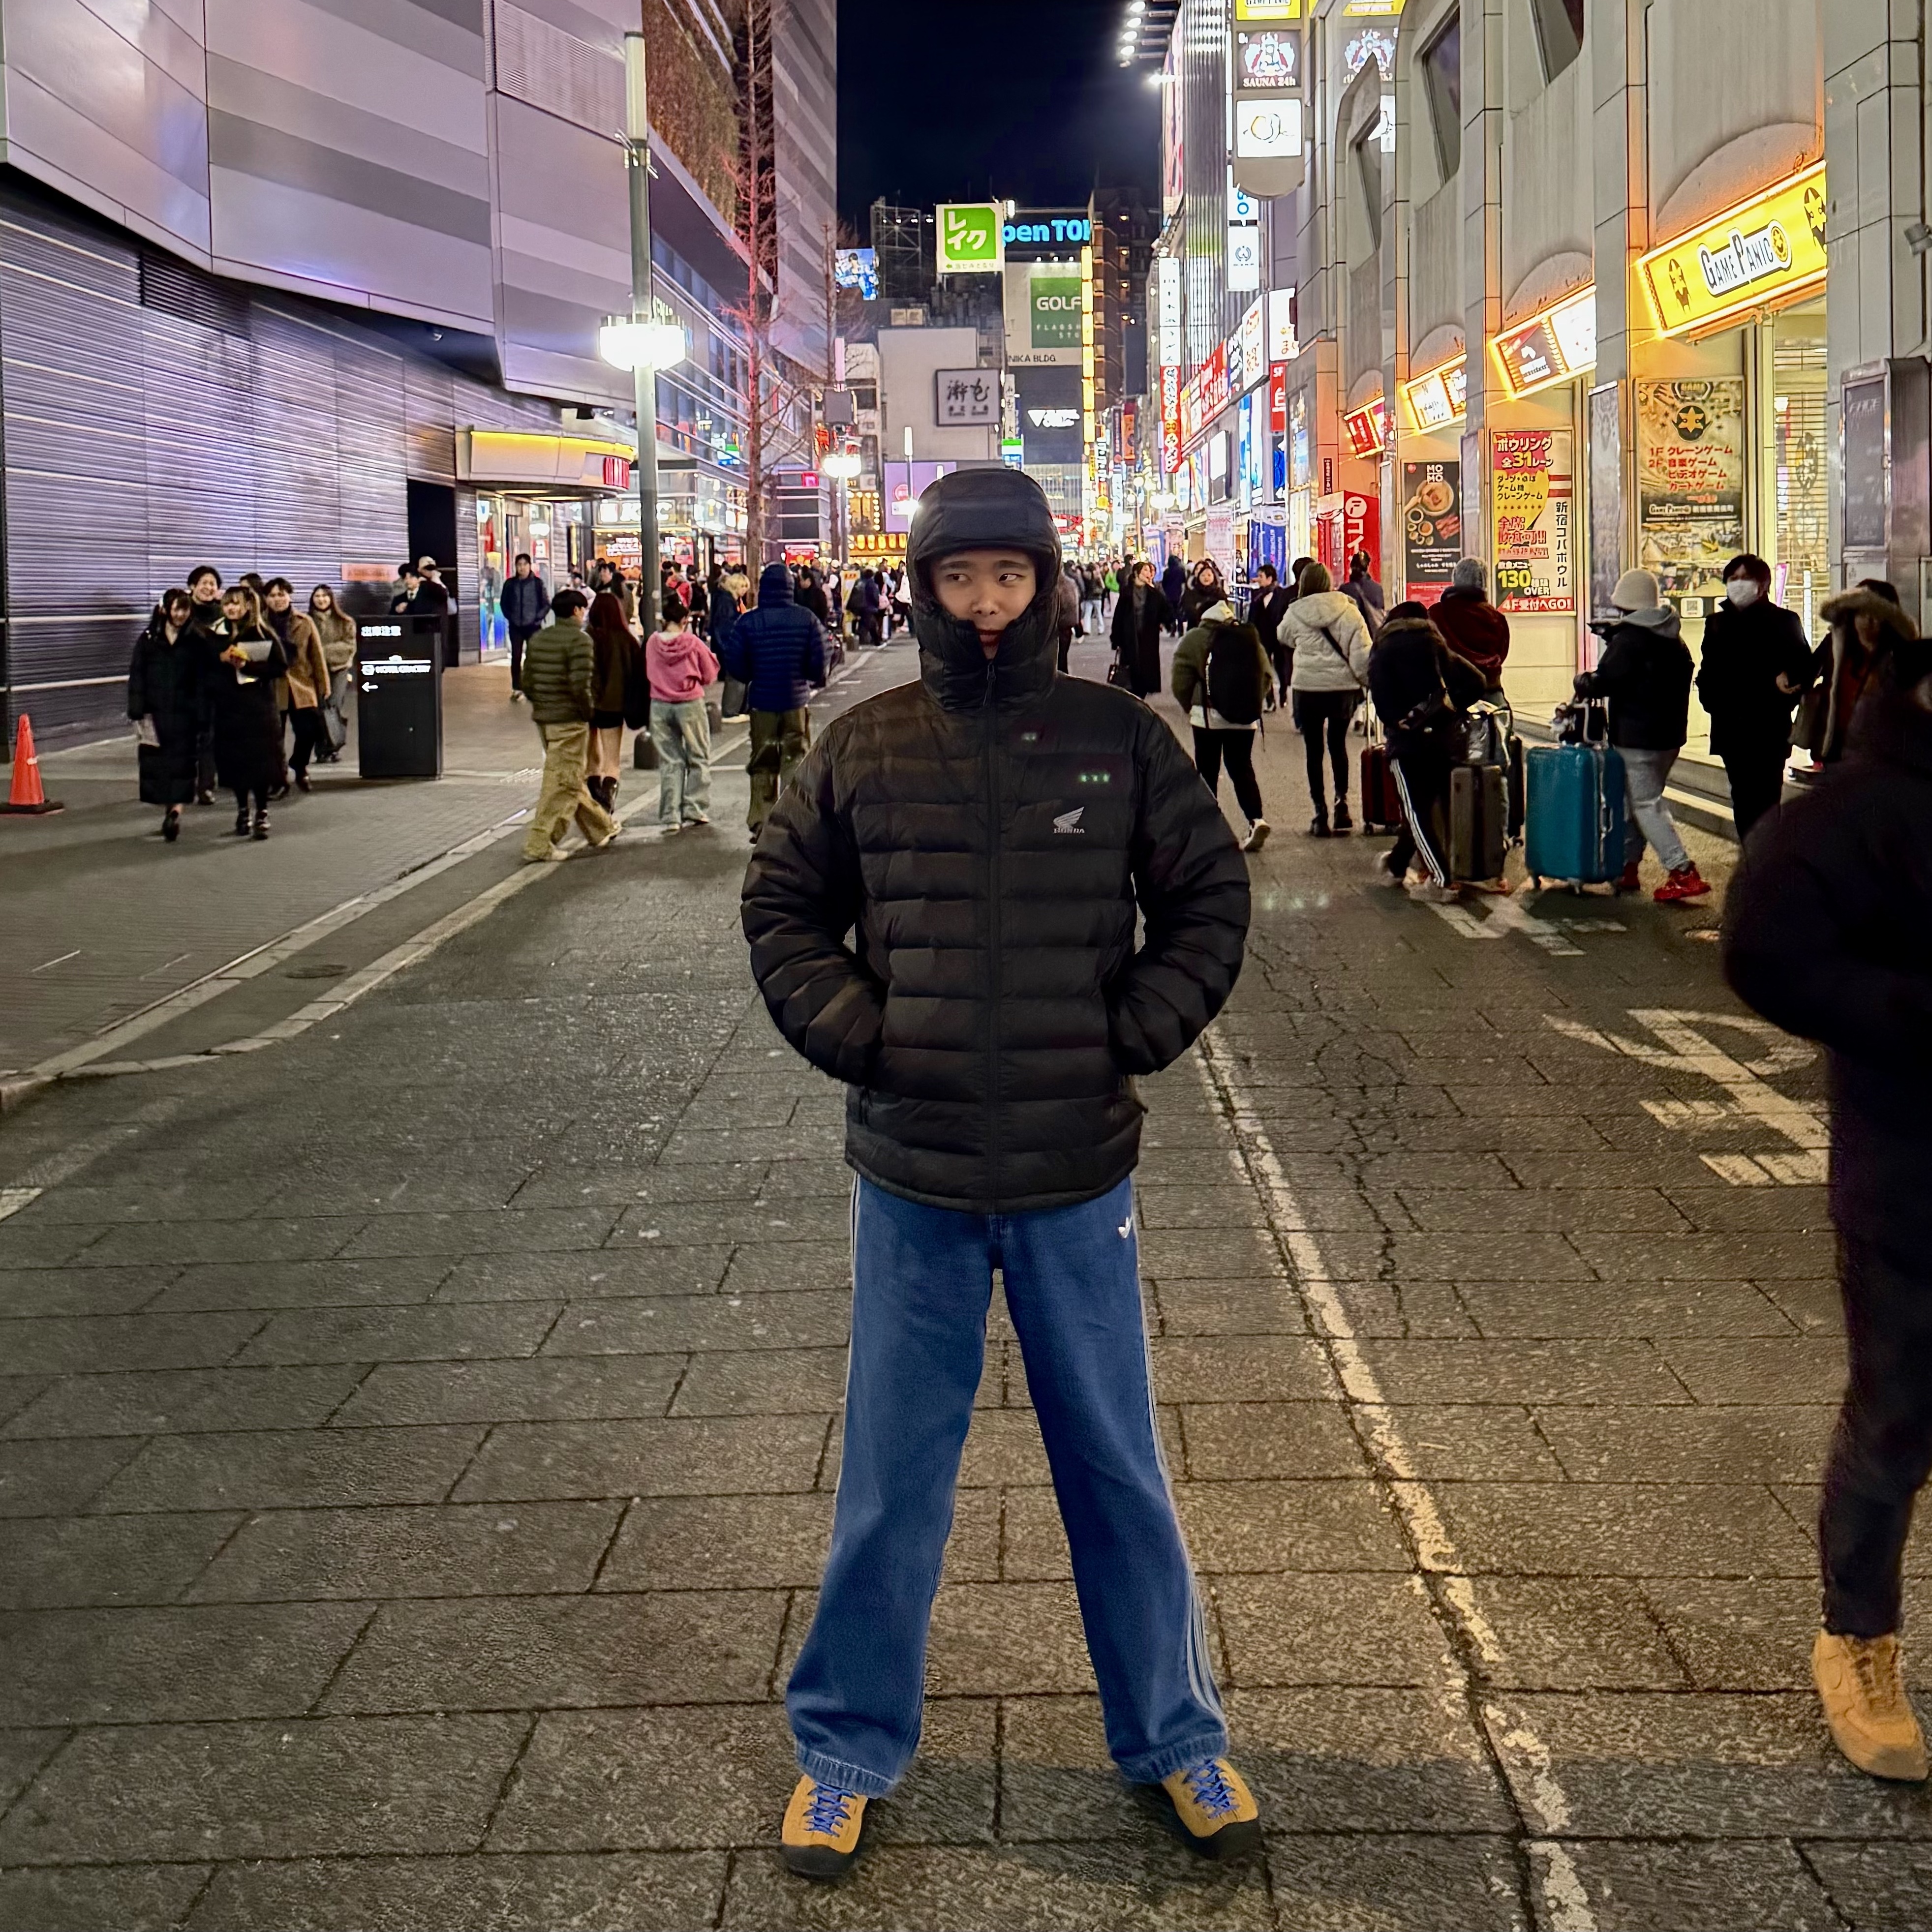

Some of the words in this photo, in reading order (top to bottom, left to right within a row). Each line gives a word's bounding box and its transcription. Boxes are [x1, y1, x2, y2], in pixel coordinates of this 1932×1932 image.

[1243, 77, 1276, 88] SAUNA
[1277, 76, 1296, 87] 24h
[947, 211, 987, 251] レイク
[1701, 250, 1738, 289] GAME
[1731, 234, 1774, 275] PANIC
[1036, 296, 1081, 311] GOLF
[1497, 436, 1553, 453] ボウリング
[1650, 447, 1664, 456] 1F
[1667, 445, 1733, 456] クレーンゲーム
[1502, 451, 1554, 468] 全31レーン
[1648, 459, 1663, 468] 2F
[1427, 464, 1443, 473] MO
[1668, 469, 1727, 479] ビデオゲーム
[1427, 474, 1443, 483] MO
[1497, 492, 1543, 501] クレーンゲーム
[620, 502, 673, 521] KC
[1524, 587, 1551, 596] OVER
